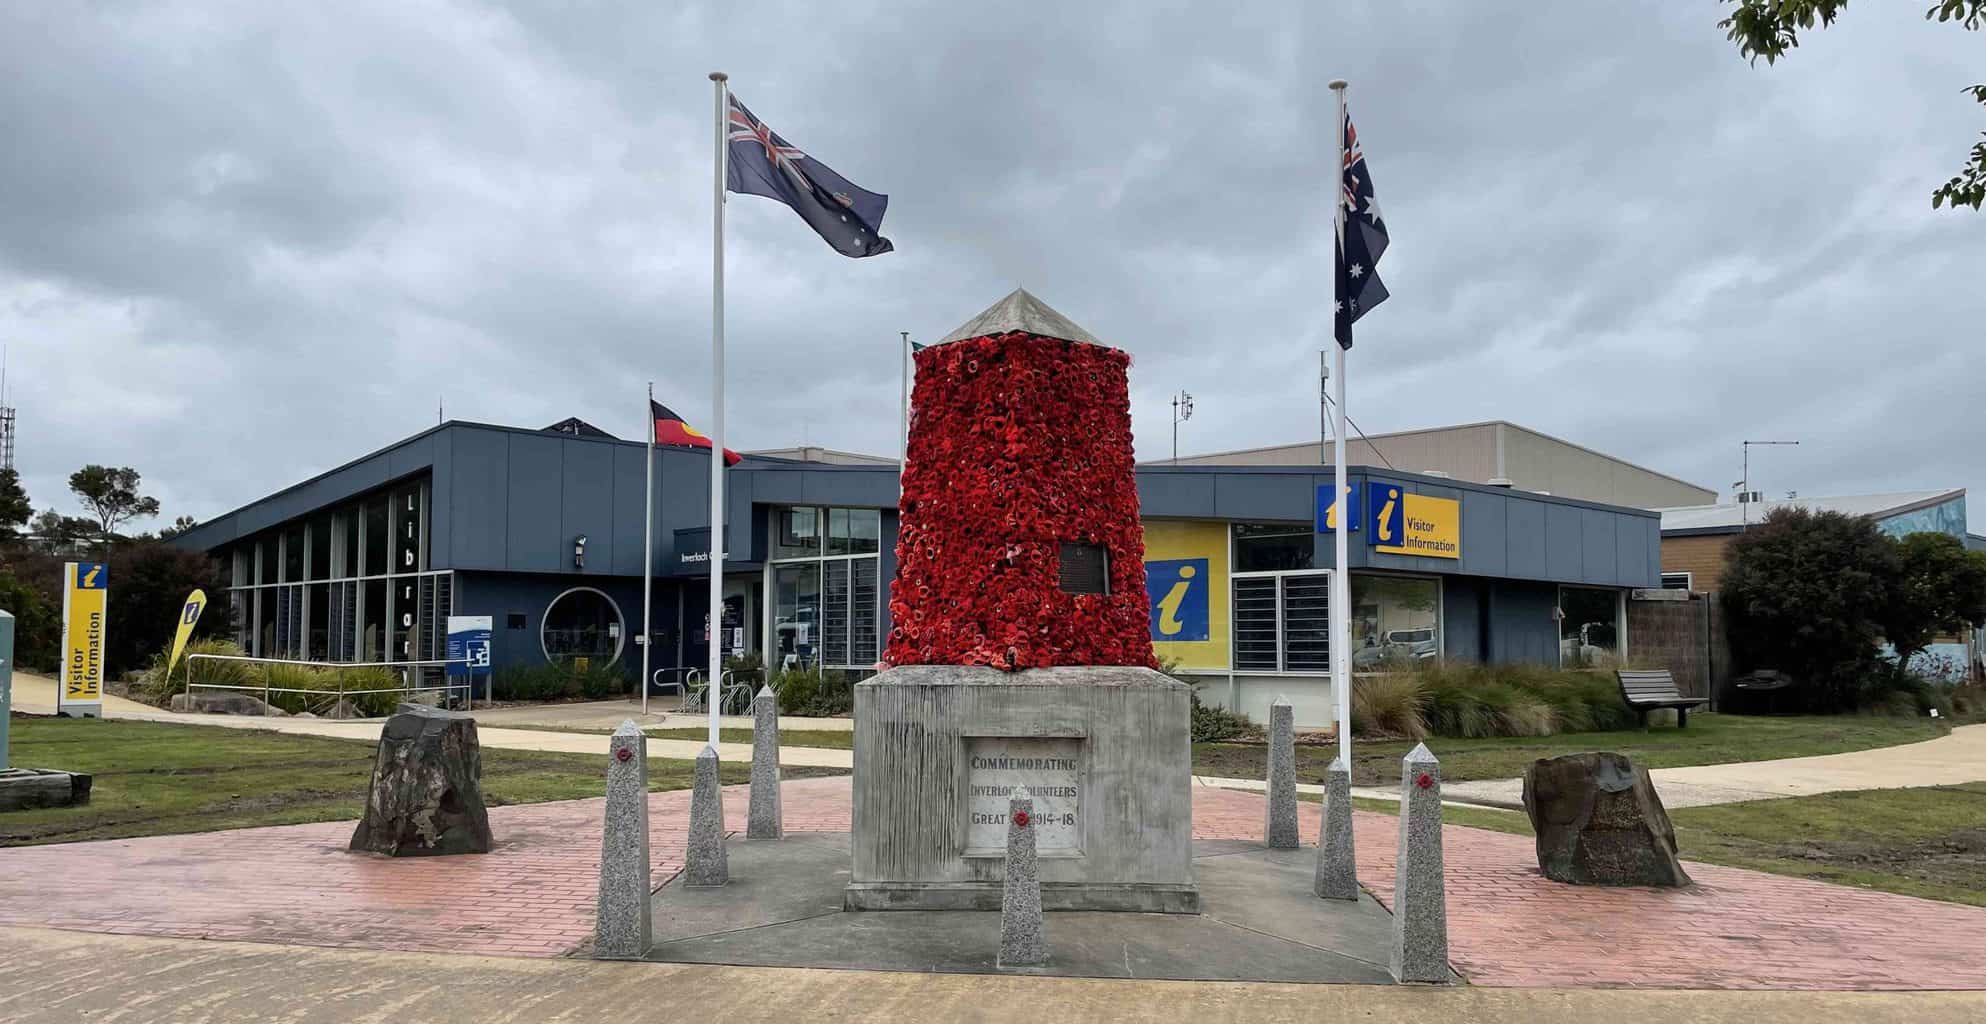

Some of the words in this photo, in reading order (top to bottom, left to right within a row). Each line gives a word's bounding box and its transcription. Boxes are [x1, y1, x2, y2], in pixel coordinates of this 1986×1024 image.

[1407, 517, 1435, 533] Visitor
[1406, 535, 1455, 552] Information
[84, 612, 101, 694] Information
[69, 648, 84, 694] Visitor
[971, 756, 1077, 770] COMMEMORATING
[1025, 785, 1077, 798] OLUNTEERS
[972, 812, 1006, 825] GREAT
